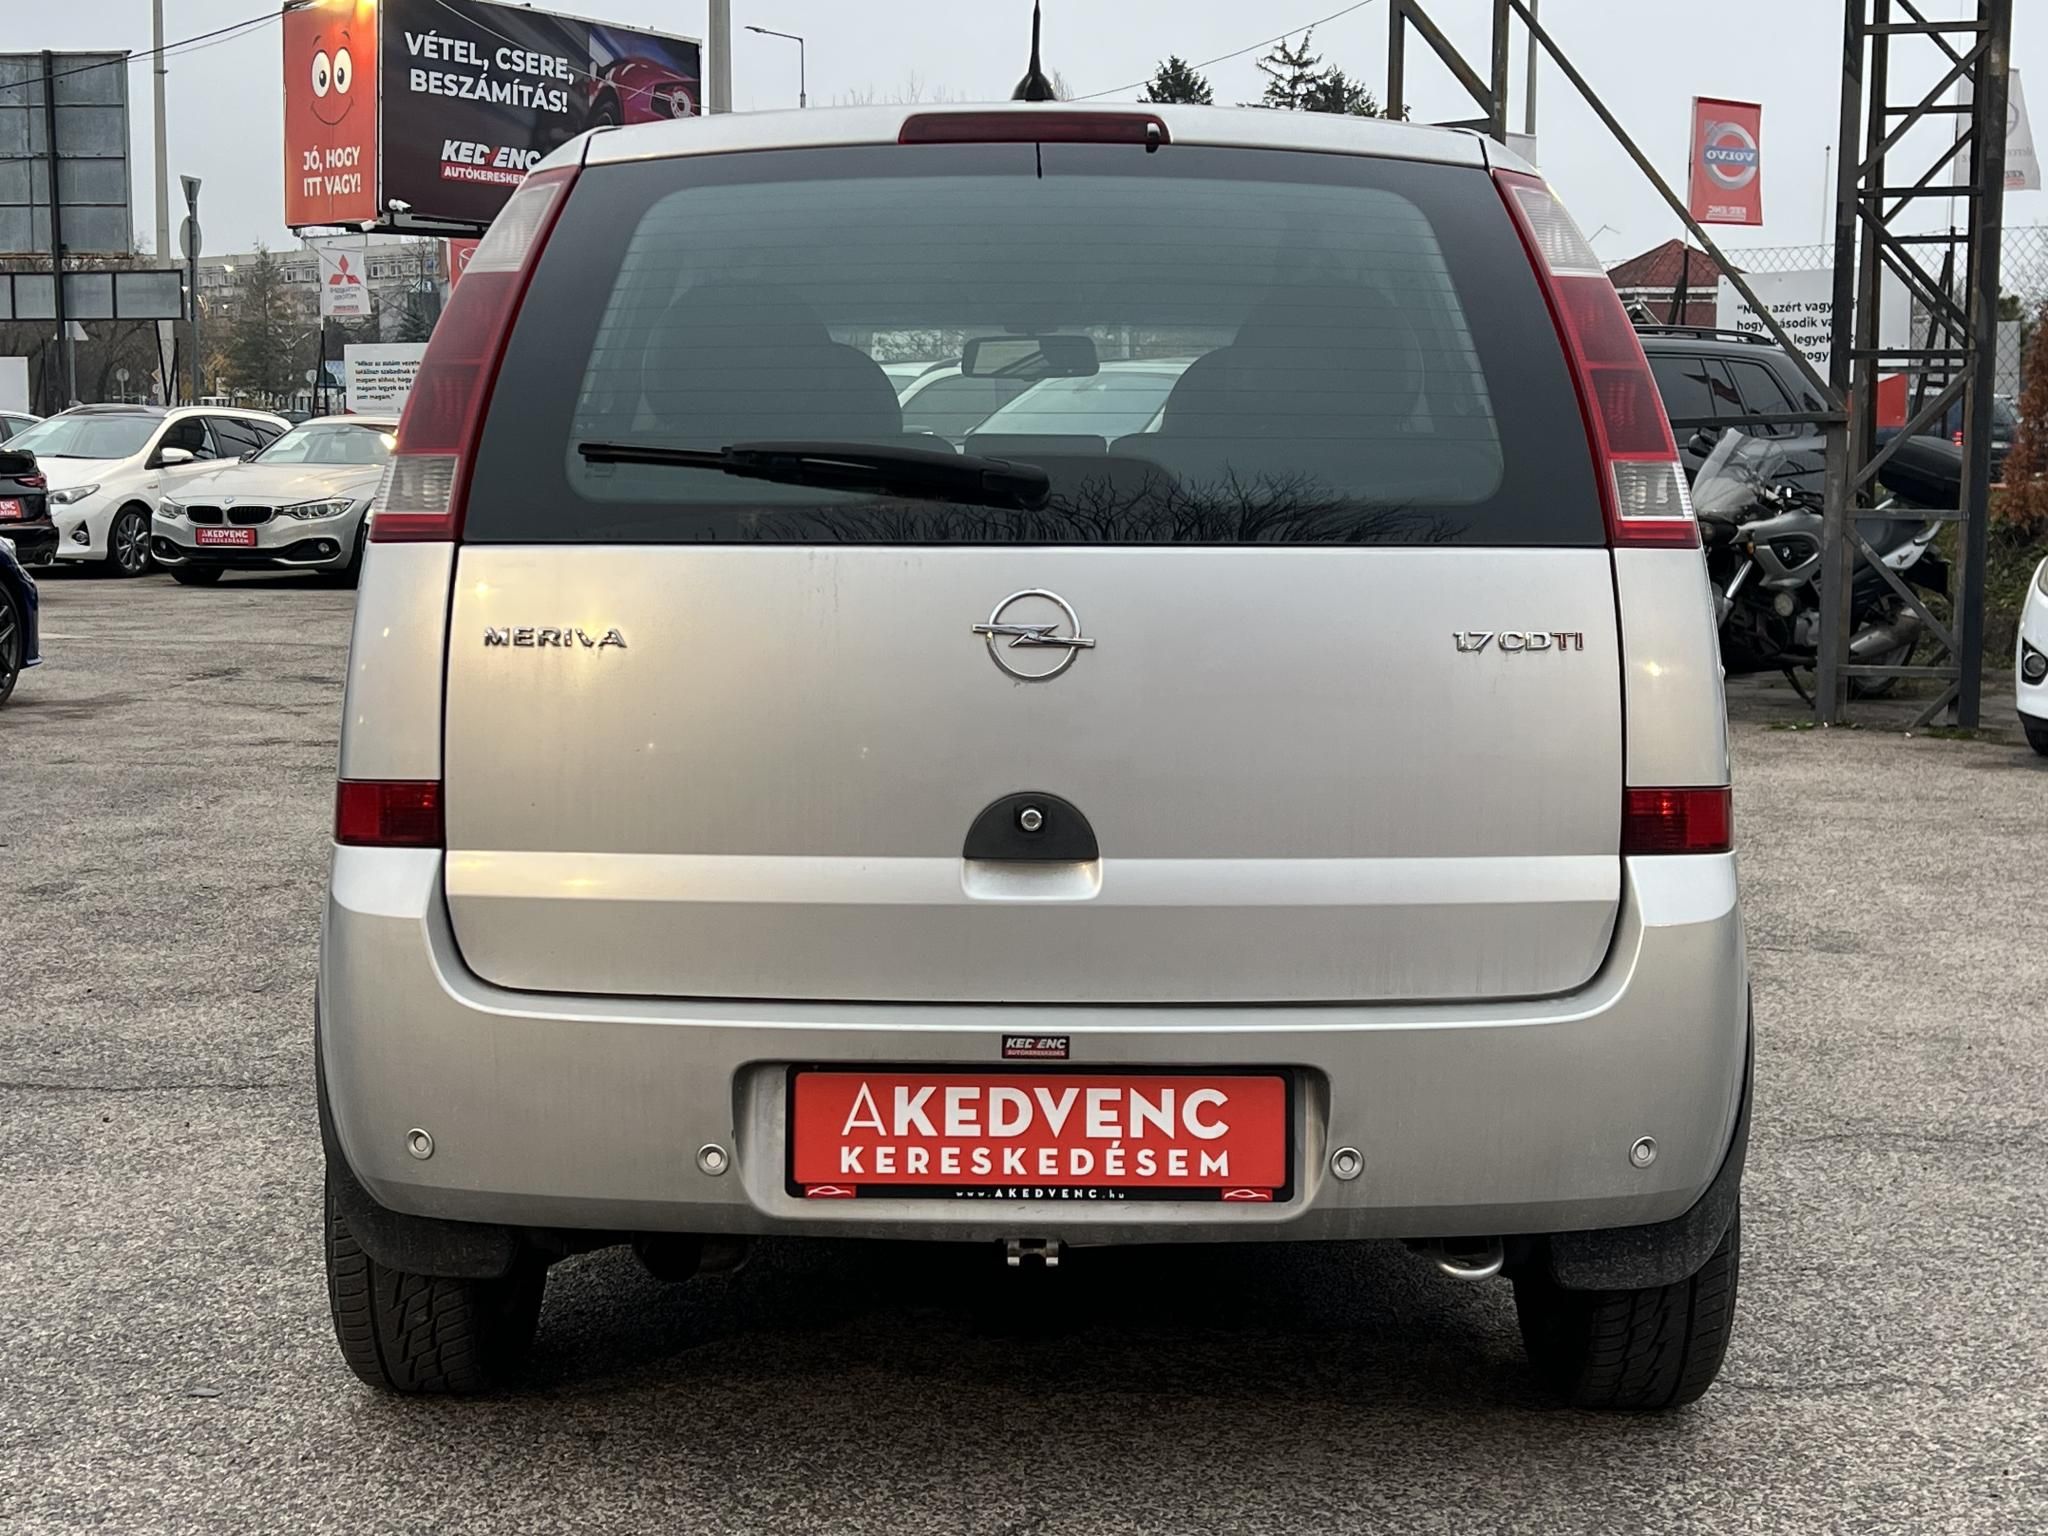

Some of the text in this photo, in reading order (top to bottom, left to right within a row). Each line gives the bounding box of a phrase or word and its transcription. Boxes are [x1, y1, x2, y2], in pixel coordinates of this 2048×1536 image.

[404, 30, 574, 84] VÉTEL, CSERE,
[410, 68, 568, 113] BESZÁMÍTÁS!
[303, 145, 361, 173] JÓ, HOGY
[304, 173, 361, 197] ITT VAGY!
[444, 166, 525, 185] AUTÓKERESKED
[1772, 301, 1801, 313] azért
[1805, 301, 1834, 314] vagy
[1737, 320, 1764, 332] hogy
[1777, 316, 1818, 329] ásodik
[201, 529, 249, 538] AKEDVENC
[484, 626, 628, 648] MERIVA
[1499, 630, 1583, 652] CDTI
[841, 1081, 1230, 1139] AKEDVENC
[840, 1140, 1230, 1177] KERESKEDÉSEM
[956, 1188, 1125, 1200] www.AKEDVENC.hu
